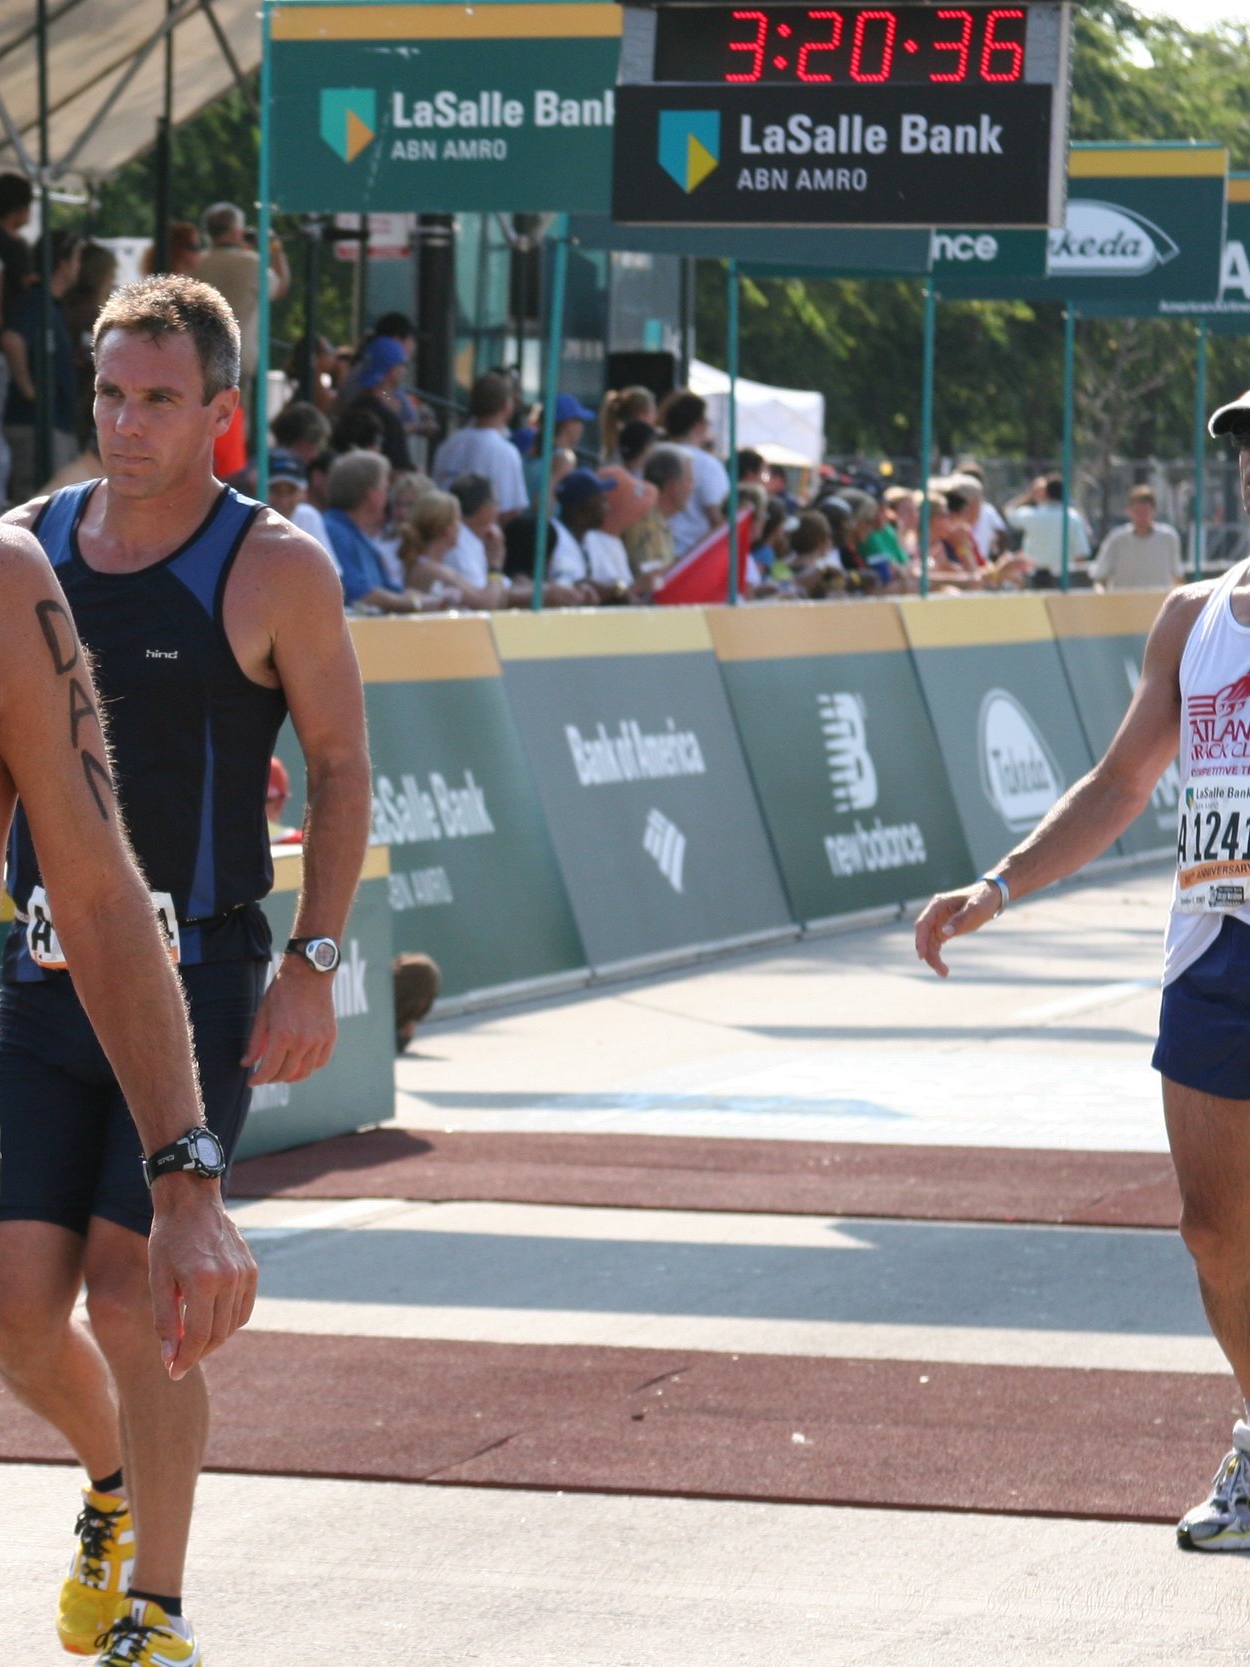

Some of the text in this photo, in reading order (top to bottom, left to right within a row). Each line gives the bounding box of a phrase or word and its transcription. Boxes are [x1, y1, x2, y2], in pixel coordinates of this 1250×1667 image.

[392, 91, 523, 129] LaSalle
[739, 112, 1003, 155] LaSalle Bank
[390, 138, 508, 161] ABN AMRO
[736, 167, 868, 193] ABN AMRO
[145, 649, 178, 660] hind
[1196, 786, 1225, 800] LaSalle
[369, 774, 442, 846] aSalle
